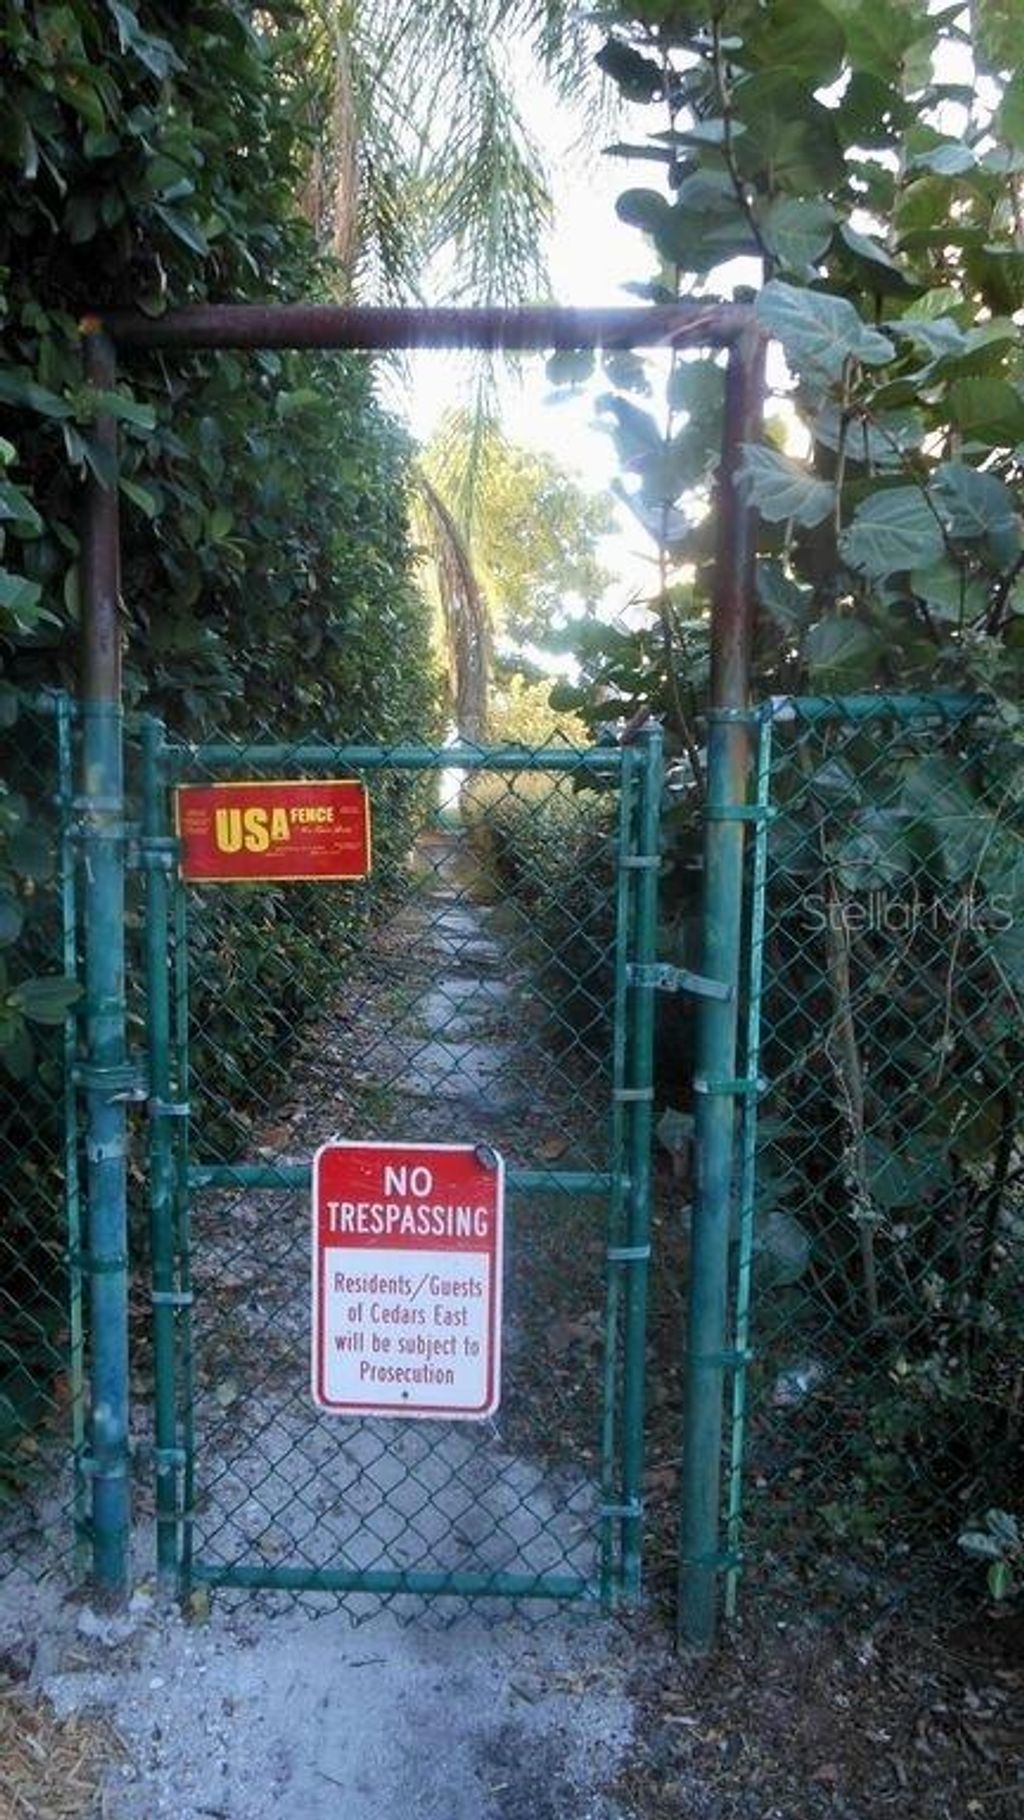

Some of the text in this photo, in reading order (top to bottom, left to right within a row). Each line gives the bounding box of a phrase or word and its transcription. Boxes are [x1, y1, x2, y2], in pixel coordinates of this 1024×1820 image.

[215, 807, 290, 853] USA
[290, 806, 334, 823] FENCE
[384, 1166, 433, 1197] NO
[327, 1202, 488, 1236] TRESPASSING
[334, 1272, 482, 1302] Residents/Guests
[348, 1304, 468, 1326] of Cedars East
[335, 1333, 480, 1361] will be subject to
[360, 1361, 454, 1385] Prosecution
